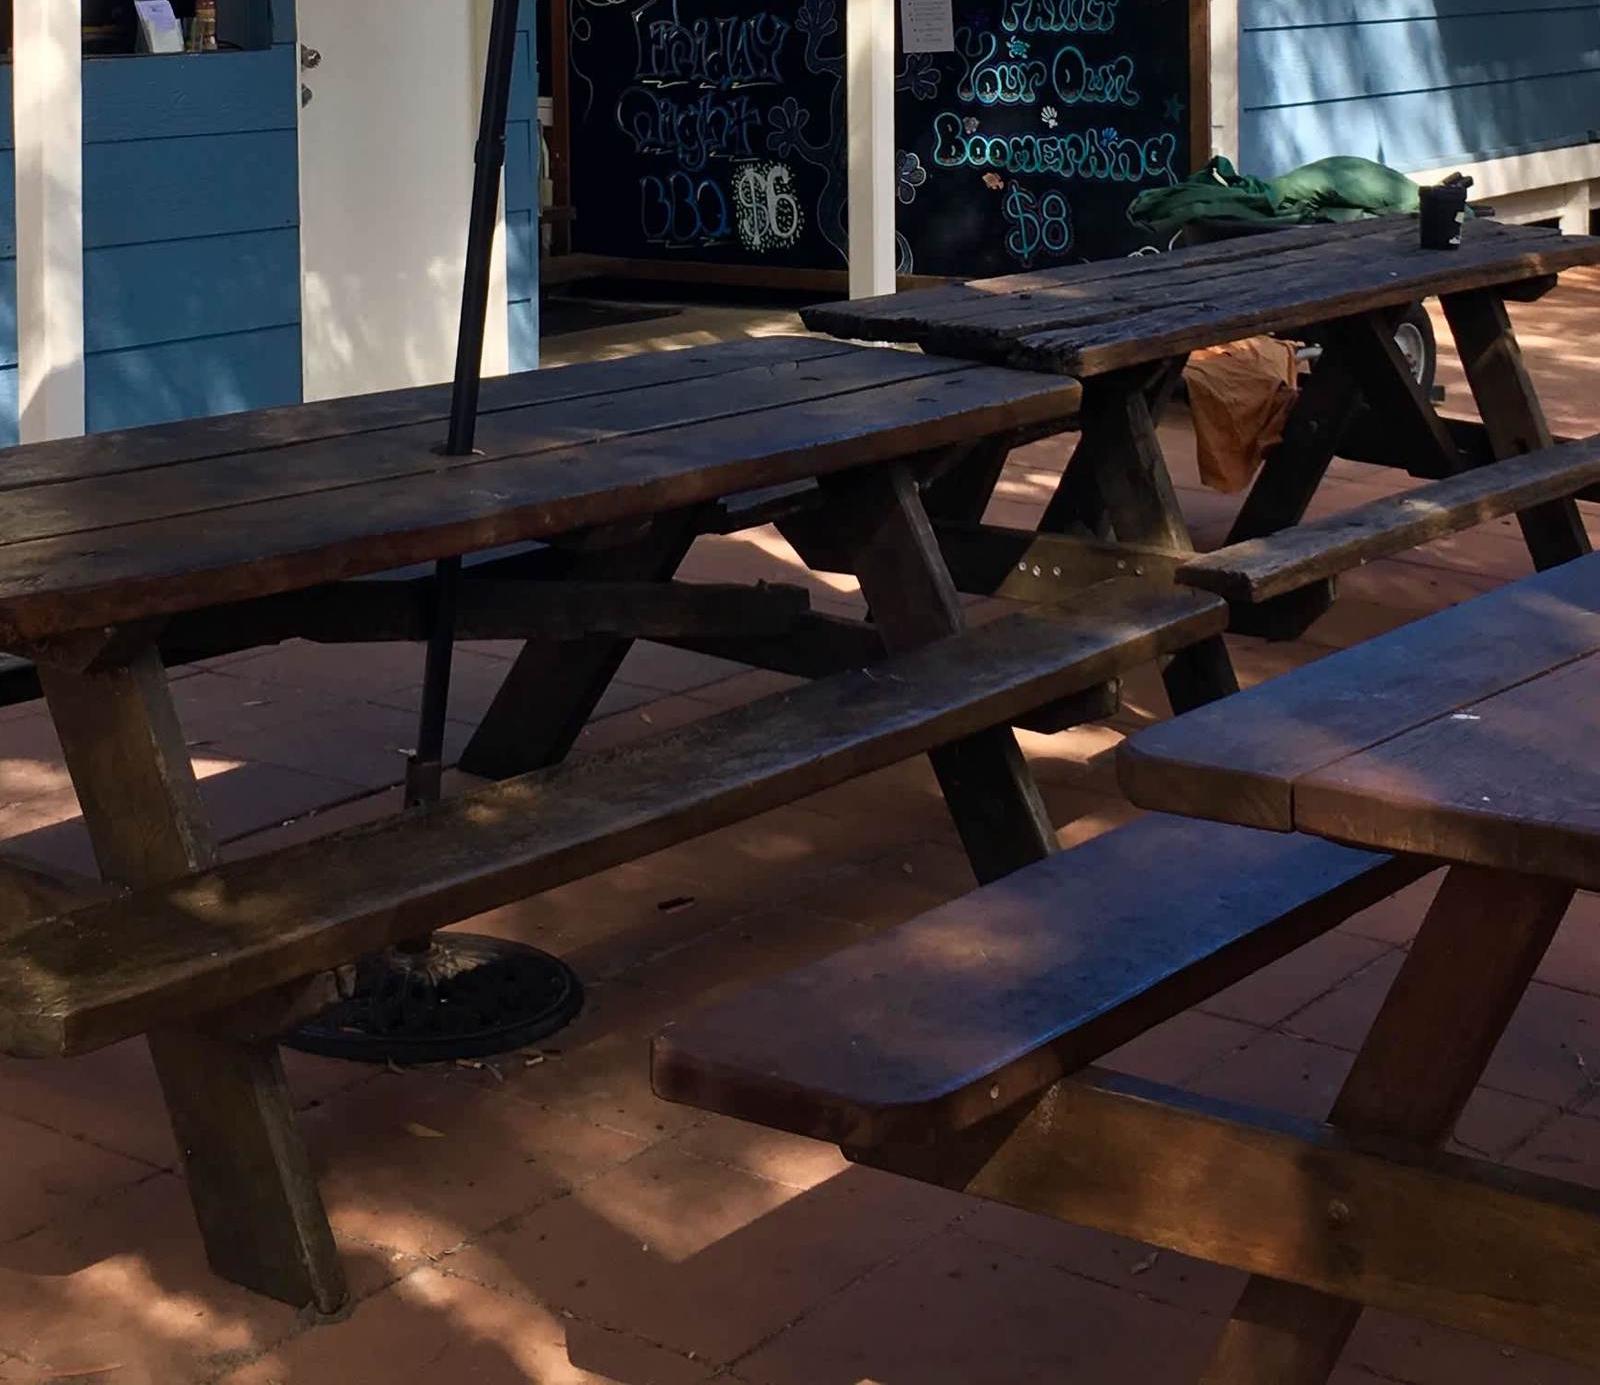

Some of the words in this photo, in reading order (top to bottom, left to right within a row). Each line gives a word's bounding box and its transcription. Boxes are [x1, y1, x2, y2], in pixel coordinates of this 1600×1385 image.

[954, 27, 1047, 105] Your
[737, 167, 800, 246] $6
[1006, 180, 1068, 259] $8
